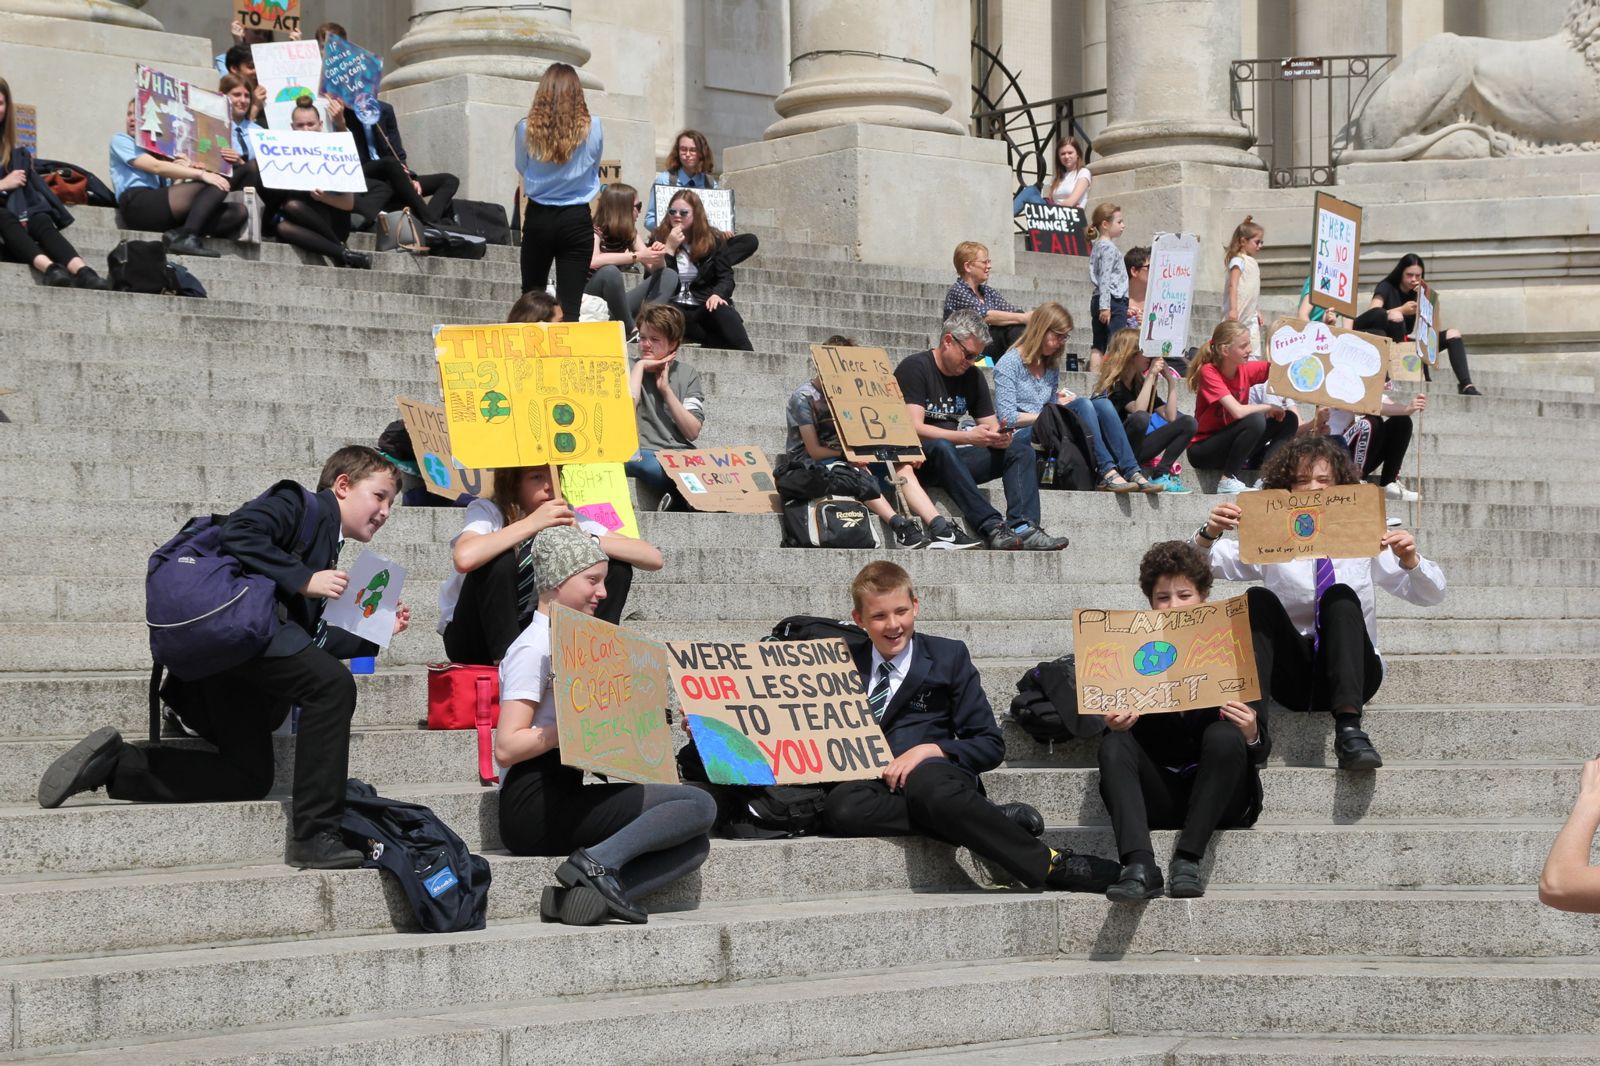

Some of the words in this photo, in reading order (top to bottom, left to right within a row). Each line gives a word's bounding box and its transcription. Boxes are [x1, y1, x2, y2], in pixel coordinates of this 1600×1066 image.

[238, 10, 262, 26] TO
[273, 15, 300, 32] ACT
[137, 67, 186, 103] WHAT
[260, 143, 322, 156] OCEANS
[323, 153, 360, 162] RISING
[1024, 203, 1080, 222] CLIMATE
[1027, 218, 1075, 232] CHANGE:
[1320, 211, 1351, 243] THERE
[1318, 238, 1330, 257] IS
[1336, 245, 1348, 263] NO
[1338, 271, 1347, 298] B
[440, 325, 572, 358] THERE
[1315, 328, 1327, 343] 4
[444, 360, 500, 390] IS
[821, 347, 868, 374] There
[873, 359, 889, 375] is
[512, 358, 625, 399] PLANET
[854, 377, 904, 400] PLANET
[401, 402, 448, 434] TIME
[860, 406, 886, 439] B
[663, 454, 680, 468] I
[709, 451, 757, 467] WAS
[836, 511, 864, 519] Reebok
[1288, 493, 1321, 508] OUR
[1079, 605, 1218, 634] PLANET
[560, 627, 586, 671] We
[589, 635, 618, 663] Can
[666, 643, 753, 671] WERE
[760, 641, 851, 667] MISSING
[570, 673, 633, 715] CREATE
[680, 674, 741, 701] OUR
[745, 669, 867, 700] LESSONS
[1082, 673, 1208, 712] BREXIT
[725, 703, 771, 736] TO
[779, 698, 880, 731] TEACH
[757, 738, 823, 776] YOU
[826, 735, 891, 772] ONE
